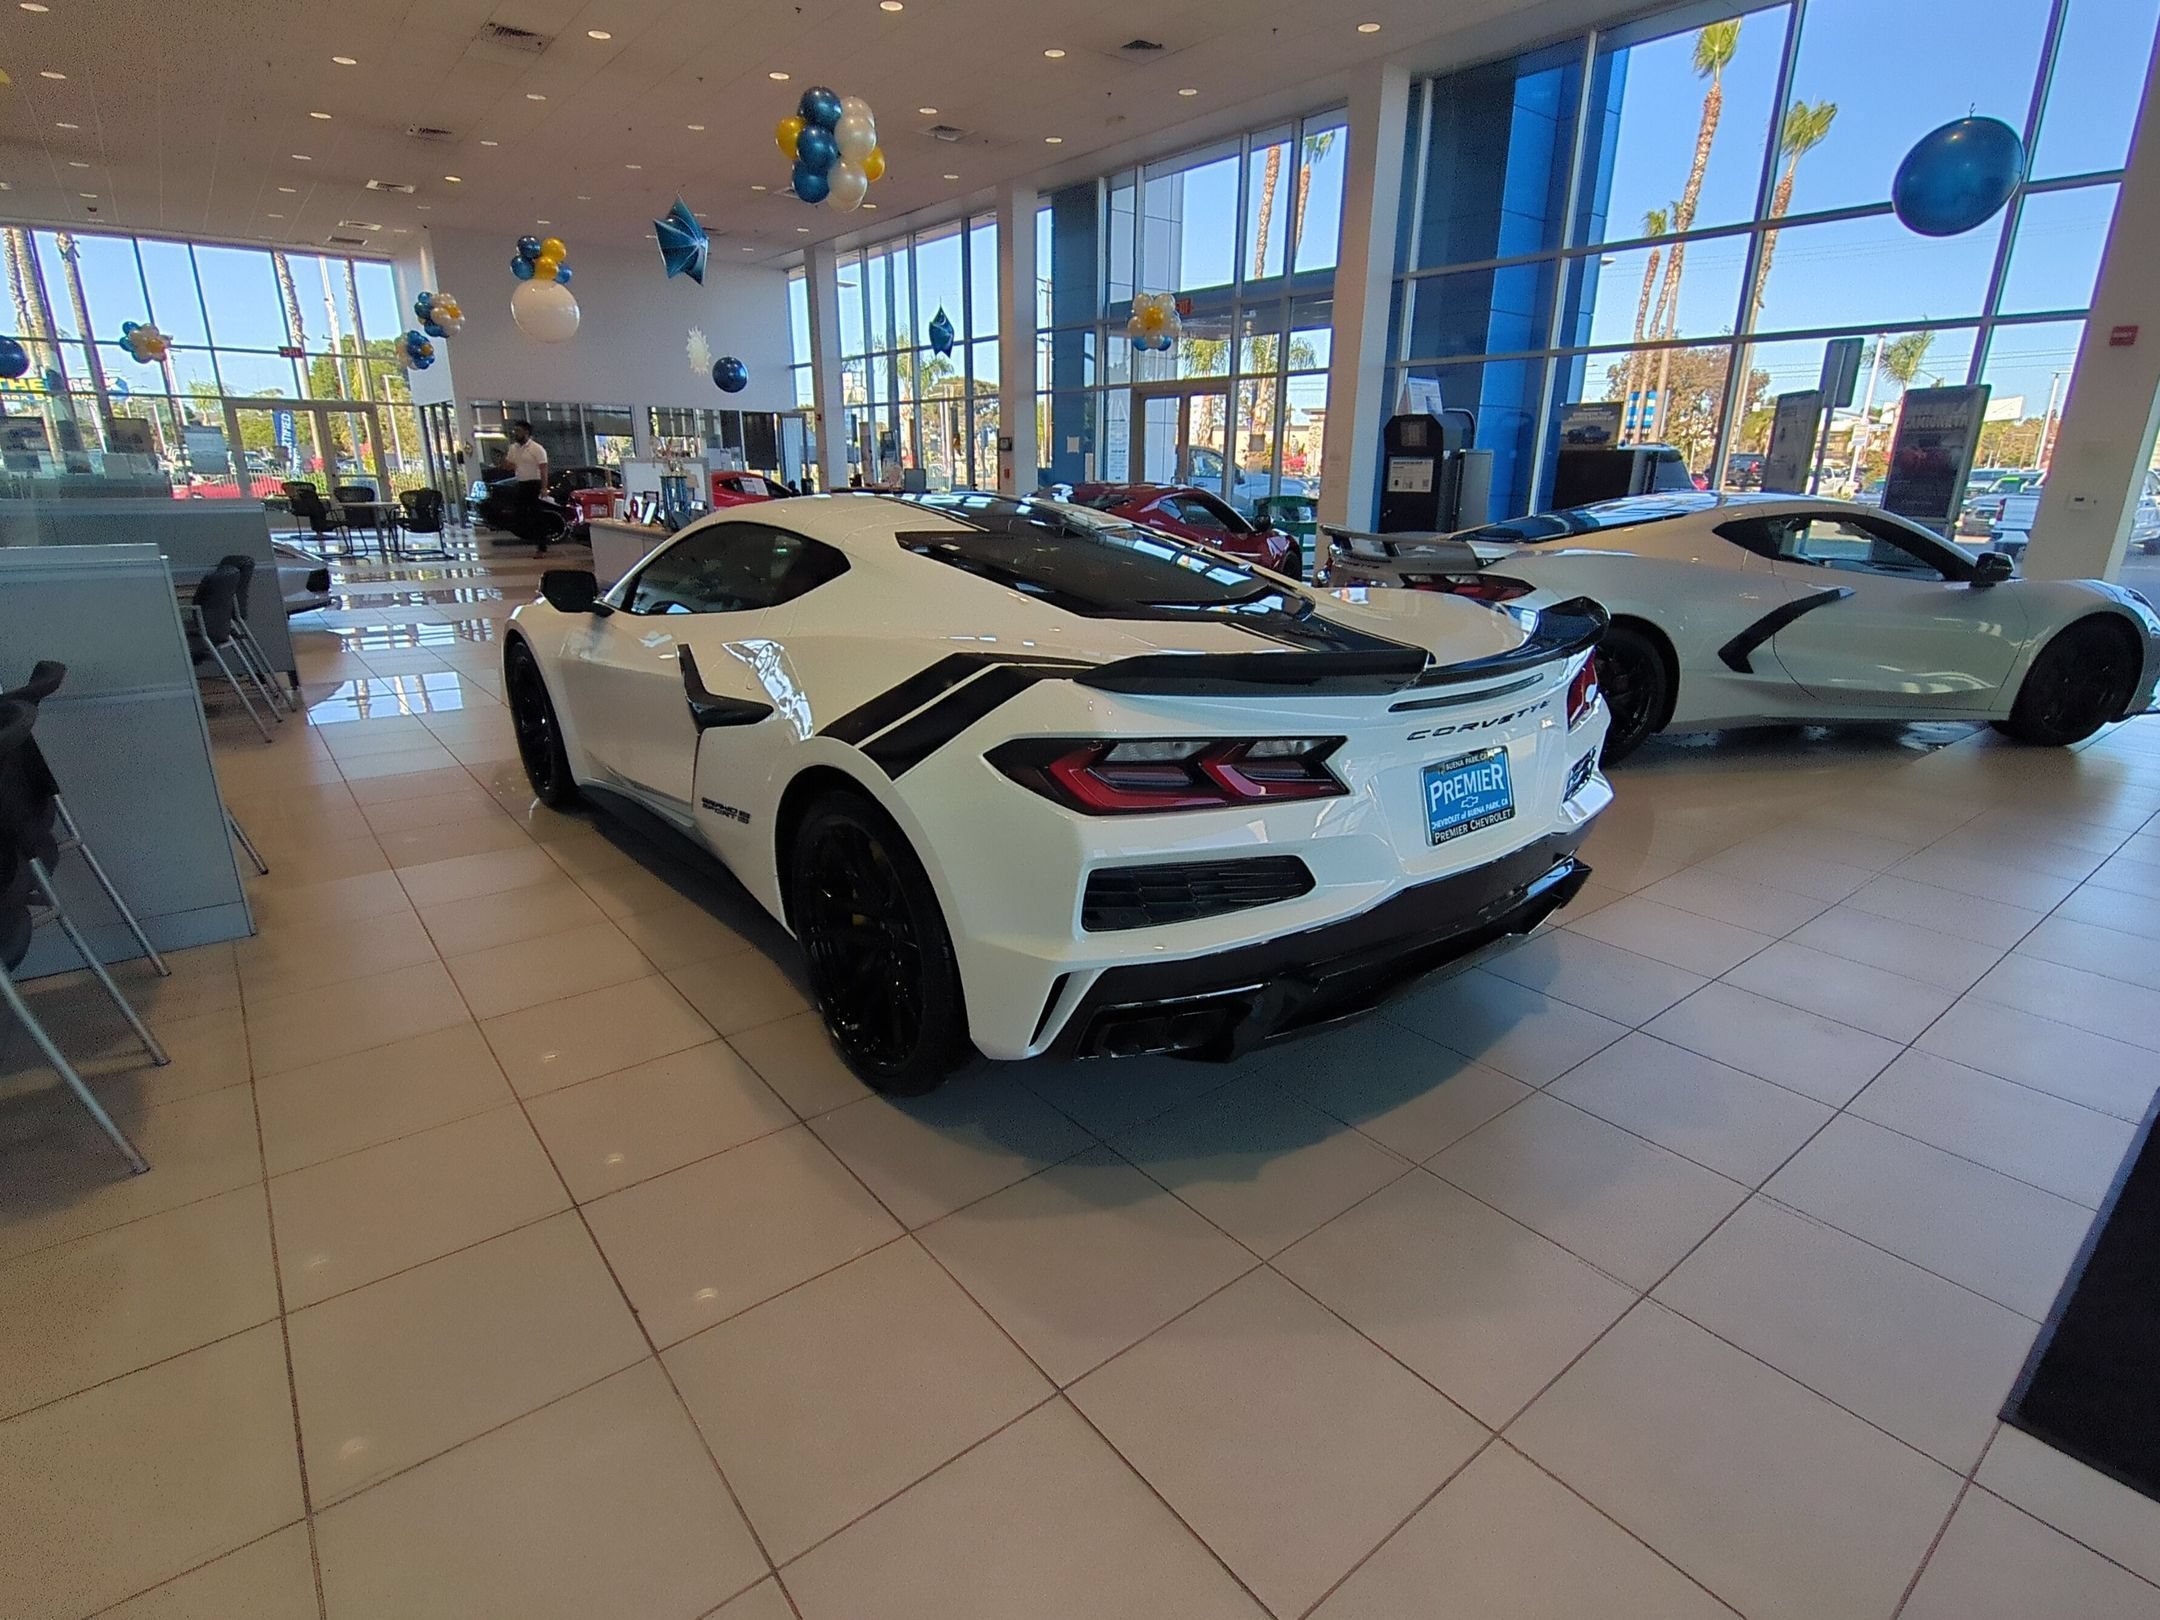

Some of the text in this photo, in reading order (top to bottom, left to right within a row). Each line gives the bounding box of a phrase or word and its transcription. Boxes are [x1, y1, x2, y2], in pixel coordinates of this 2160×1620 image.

[1406, 700, 1550, 740] CORVETTE
[1445, 759, 1465, 771] BUENA
[1430, 764, 1505, 813] PREMIER
[1434, 808, 1512, 844] PREMIER CHEVROLET
[1467, 806, 1485, 818] BUENA
